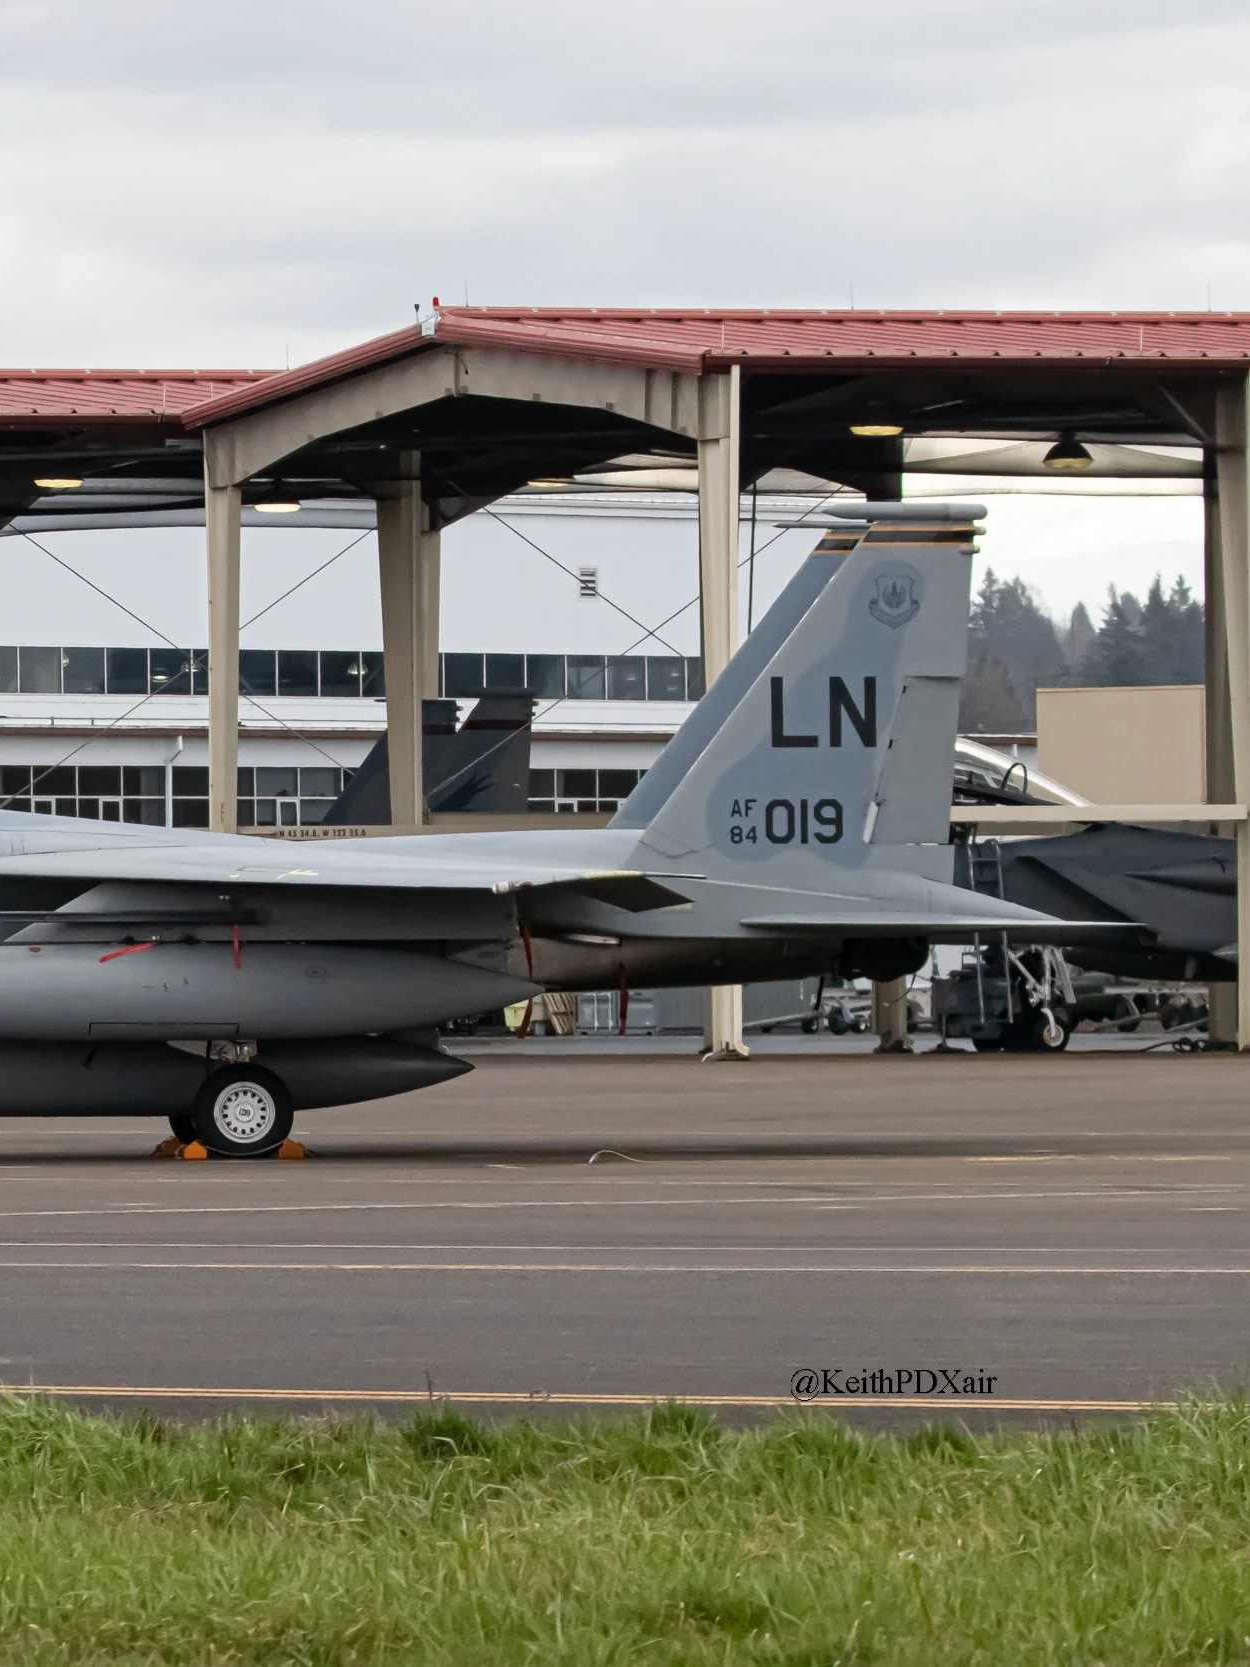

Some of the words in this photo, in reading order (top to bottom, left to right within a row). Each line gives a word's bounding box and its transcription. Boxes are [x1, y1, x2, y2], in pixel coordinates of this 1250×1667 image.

[770, 675, 877, 748] LN
[730, 798, 758, 818] AF
[765, 798, 844, 845] 019
[279, 830, 285, 838] N
[287, 830, 297, 838] 45
[322, 829, 330, 837] W
[729, 825, 758, 845] 84
